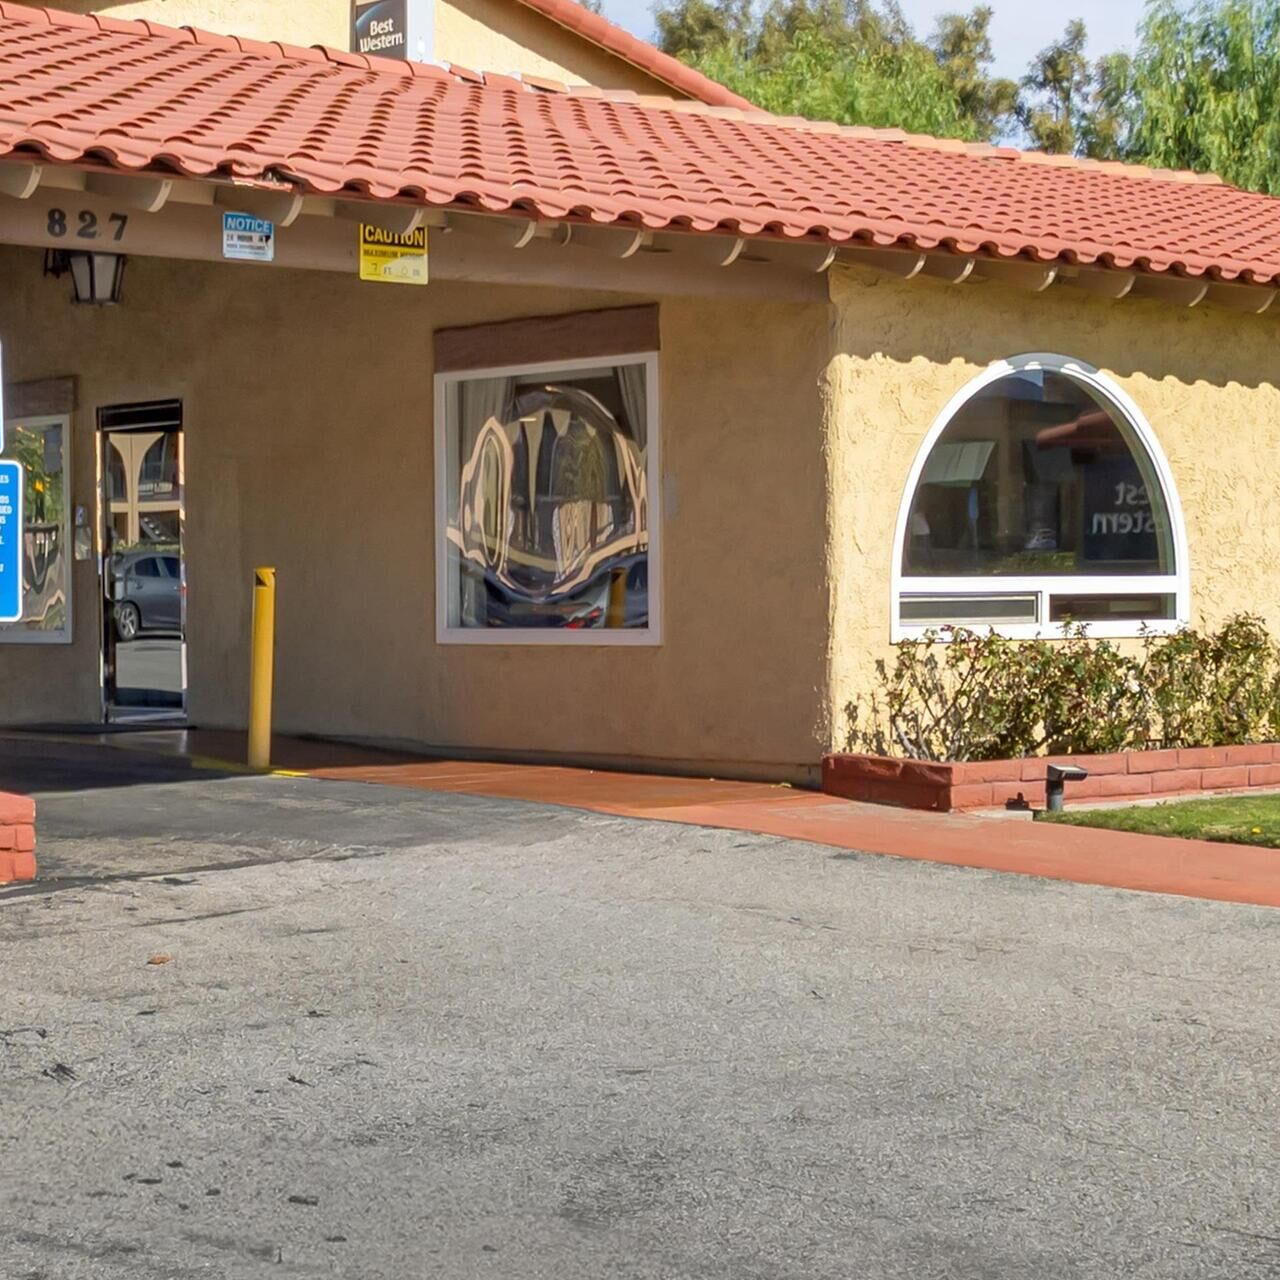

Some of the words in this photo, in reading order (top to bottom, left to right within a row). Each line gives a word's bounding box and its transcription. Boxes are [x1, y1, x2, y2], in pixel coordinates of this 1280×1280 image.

[370, 17, 394, 36] Best
[359, 32, 404, 53] Western
[47, 208, 128, 241] 827
[227, 217, 271, 234] NOTICE
